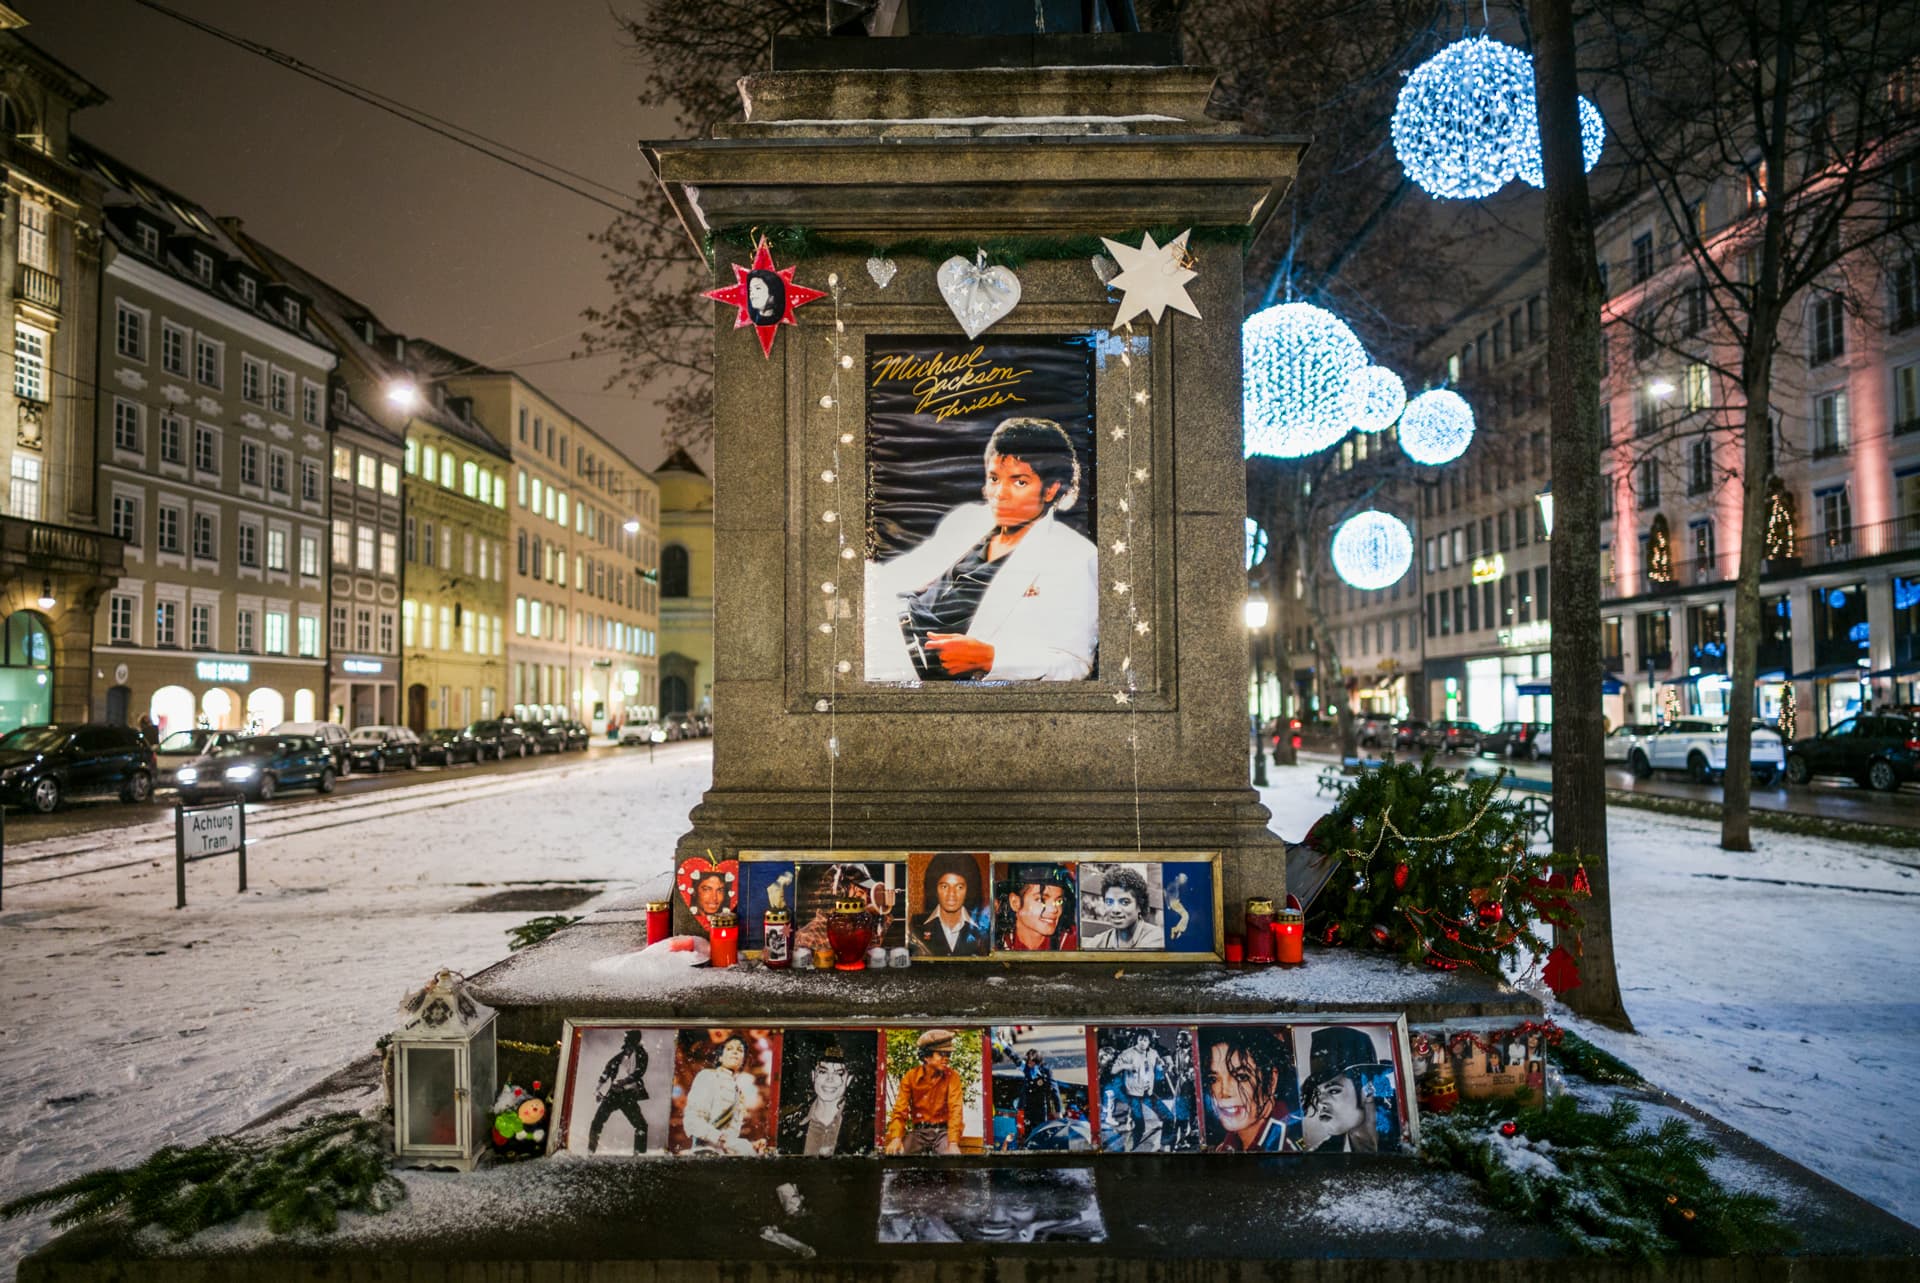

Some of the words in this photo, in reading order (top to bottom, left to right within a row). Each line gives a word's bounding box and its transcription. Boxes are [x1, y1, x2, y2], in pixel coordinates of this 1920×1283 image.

[872, 345, 992, 387] Michael
[913, 368, 1032, 414] Jackson
[932, 391, 1026, 423] Thriller
[192, 815, 233, 832] Achtung
[201, 835, 228, 850] Tram
